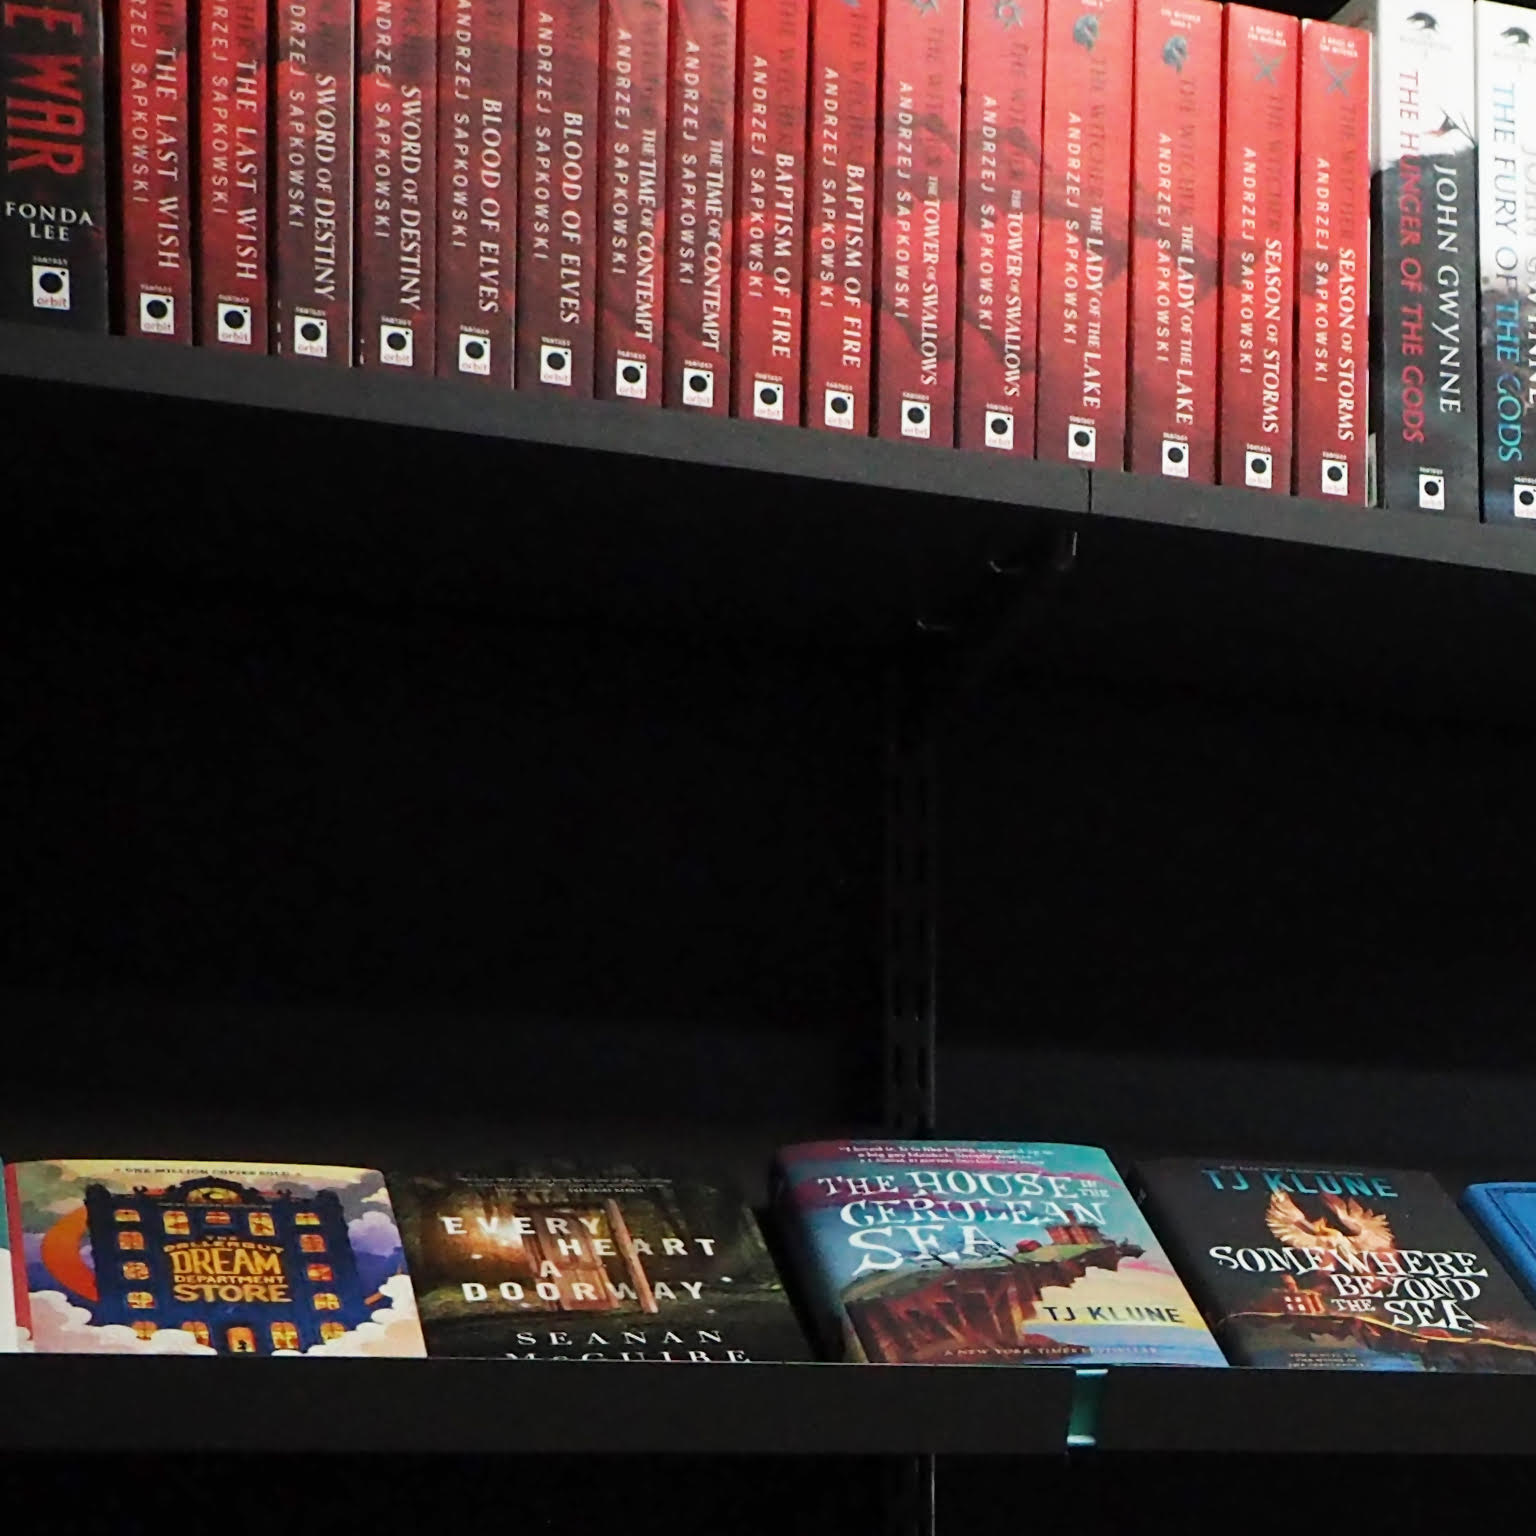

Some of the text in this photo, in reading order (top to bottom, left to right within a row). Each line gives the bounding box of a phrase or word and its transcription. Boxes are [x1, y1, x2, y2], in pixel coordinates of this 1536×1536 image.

[6, 54, 86, 176] WAR
[772, 153, 794, 358] BAPTISM OF FIRE
[1399, 71, 1425, 443] THE HUNGER OF THE GODS
[1315, 157, 1330, 383] ANDRZEJ SAPKOWSKI
[1336, 247, 1356, 442] SEASON OF STORMS
[818, 1170, 1079, 1200] THE HOUSE
[442, 1216, 601, 1237] EVERY
[840, 1198, 1106, 1228] CERULEAN
[169, 1248, 283, 1275] DREAM
[556, 1239, 717, 1258] HEART
[849, 1225, 1015, 1276] SEA
[1209, 1245, 1488, 1278] SOMEWHERE
[174, 1275, 285, 1284] DEPARTMENT
[540, 1260, 563, 1279] A
[173, 1284, 293, 1302] STORE
[462, 1281, 706, 1302] DOORWAY
[1330, 1274, 1480, 1301] BEYOND
[1043, 1306, 1184, 1323] TJ KLUNE
[1331, 1299, 1490, 1333] THE SEA
[517, 1330, 726, 1346] SEANAN
